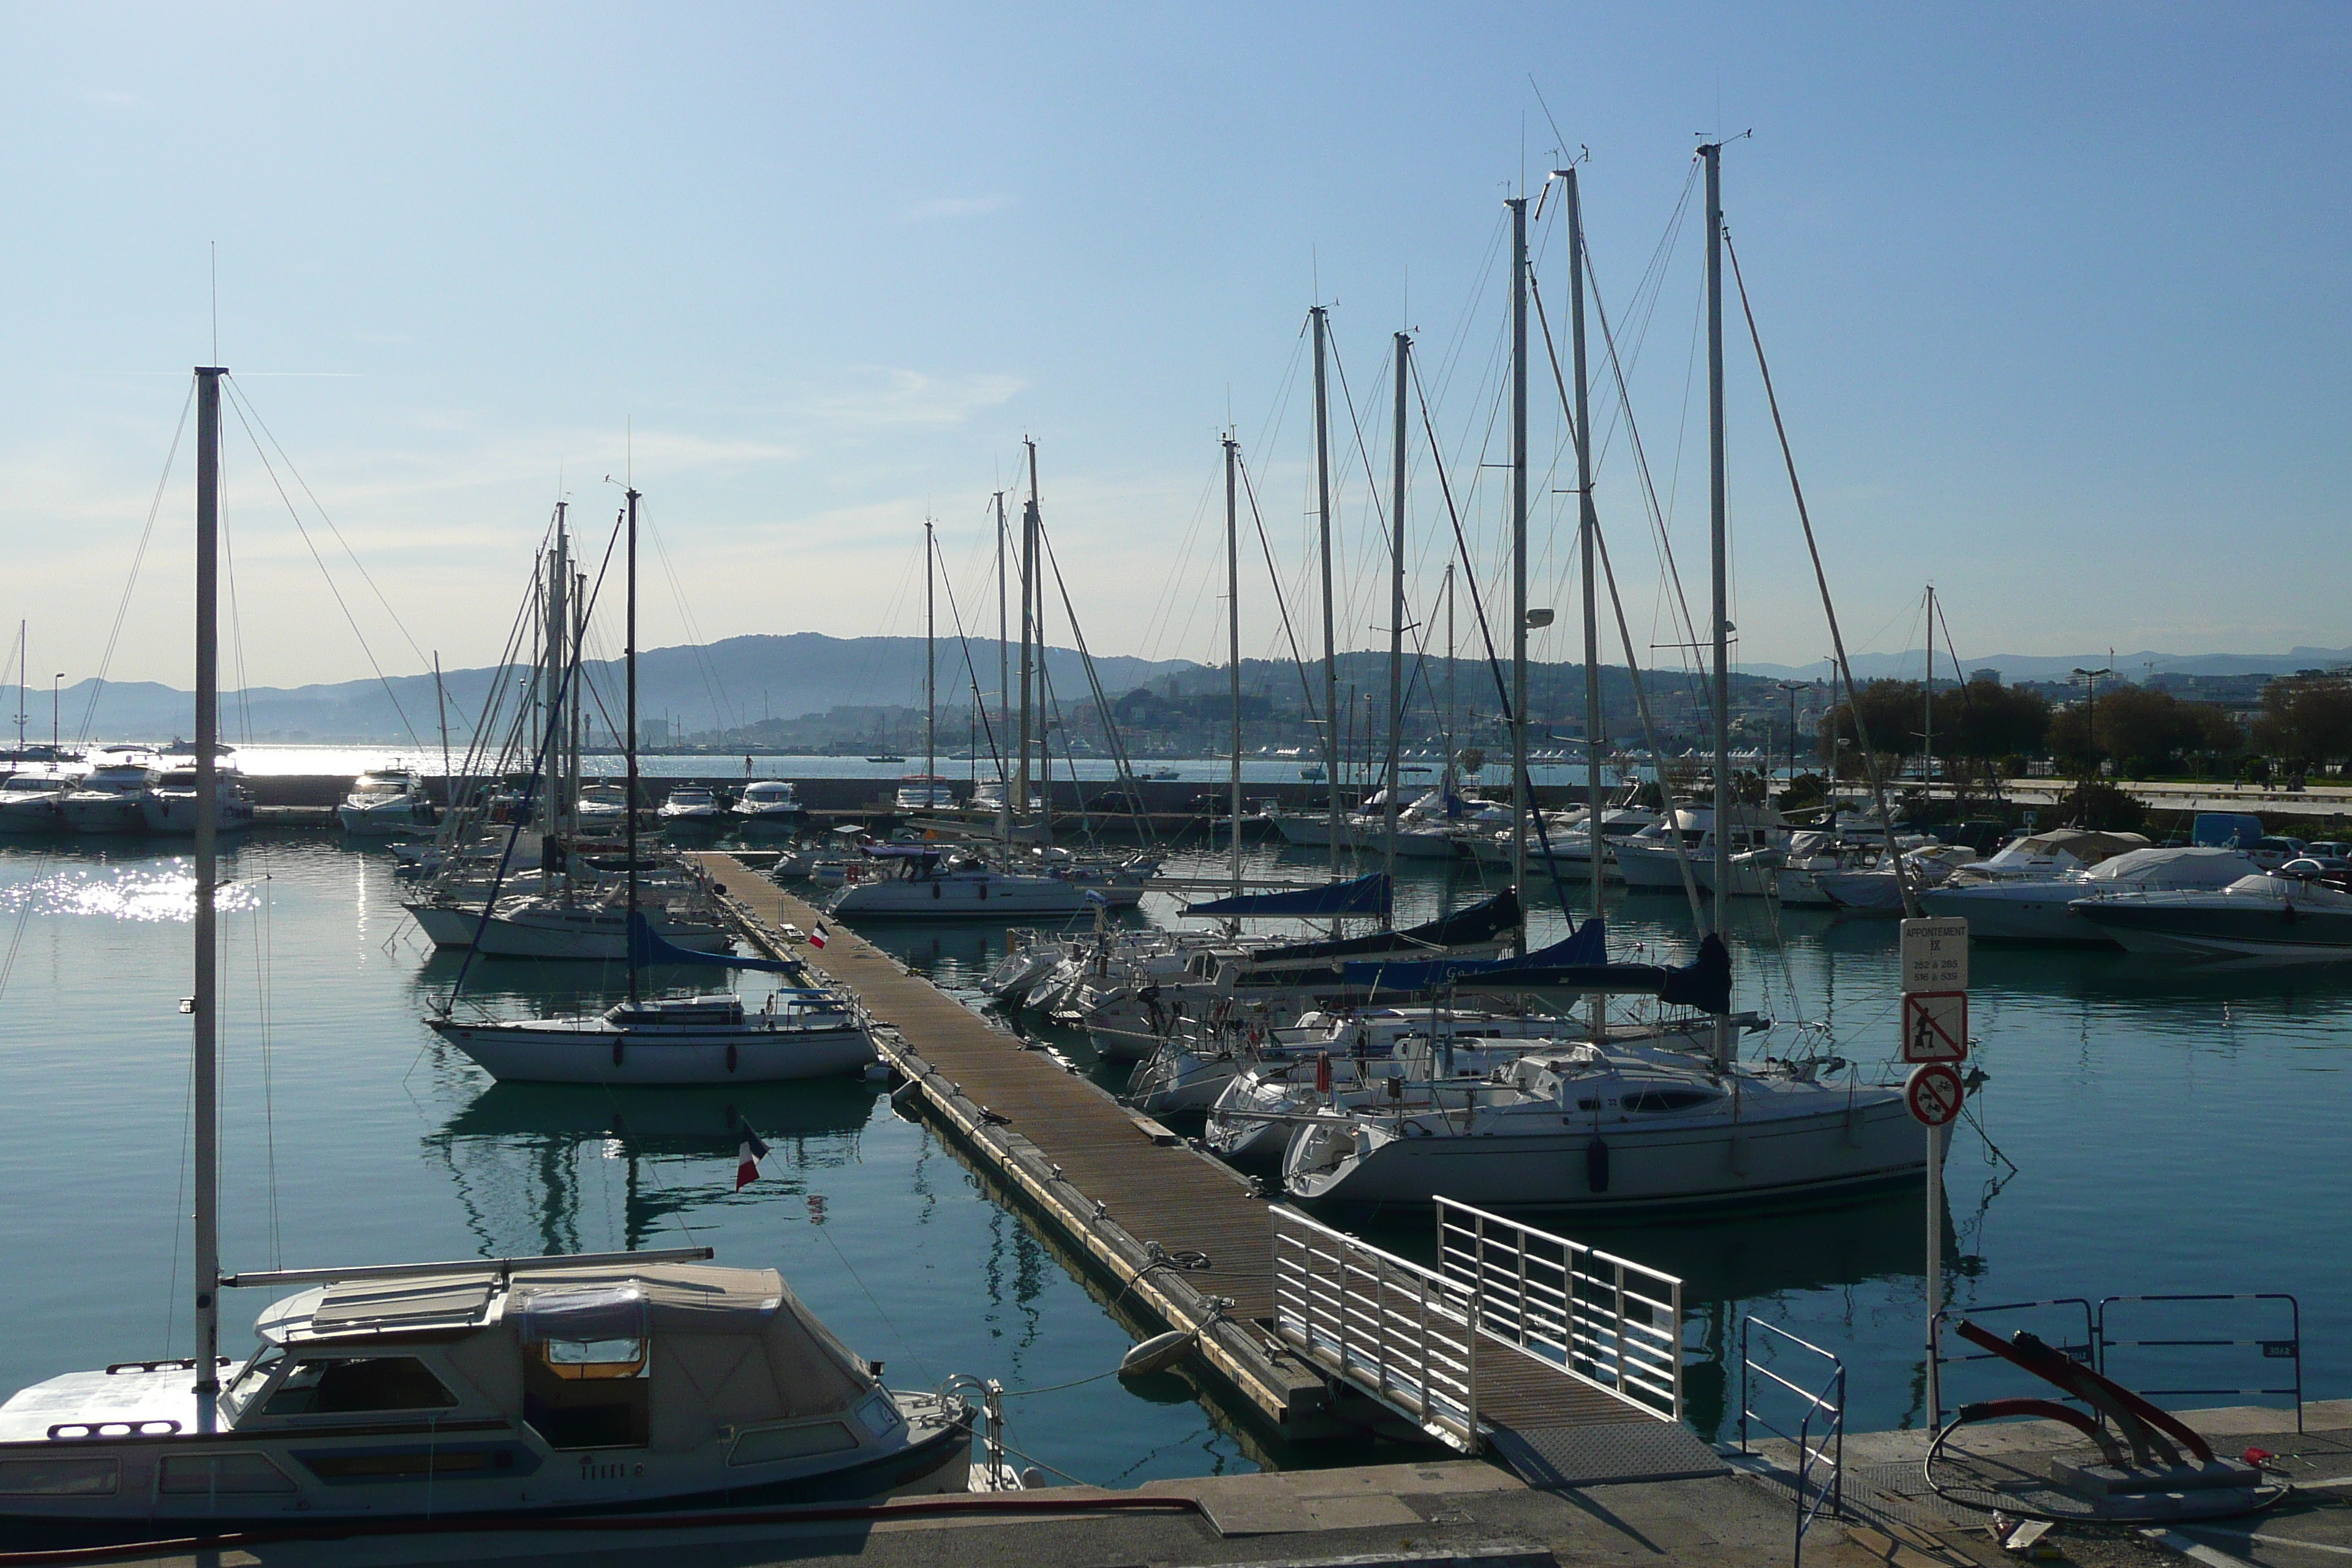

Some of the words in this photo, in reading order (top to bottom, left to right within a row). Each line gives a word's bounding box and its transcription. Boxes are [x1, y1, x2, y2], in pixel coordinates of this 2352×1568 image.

[1906, 926, 1966, 938] APPONTEMENT
[1930, 940, 1941, 951] IX
[1913, 961, 1930, 969] 252
[1941, 960, 1958, 968] 285
[1914, 973, 1929, 981] 516
